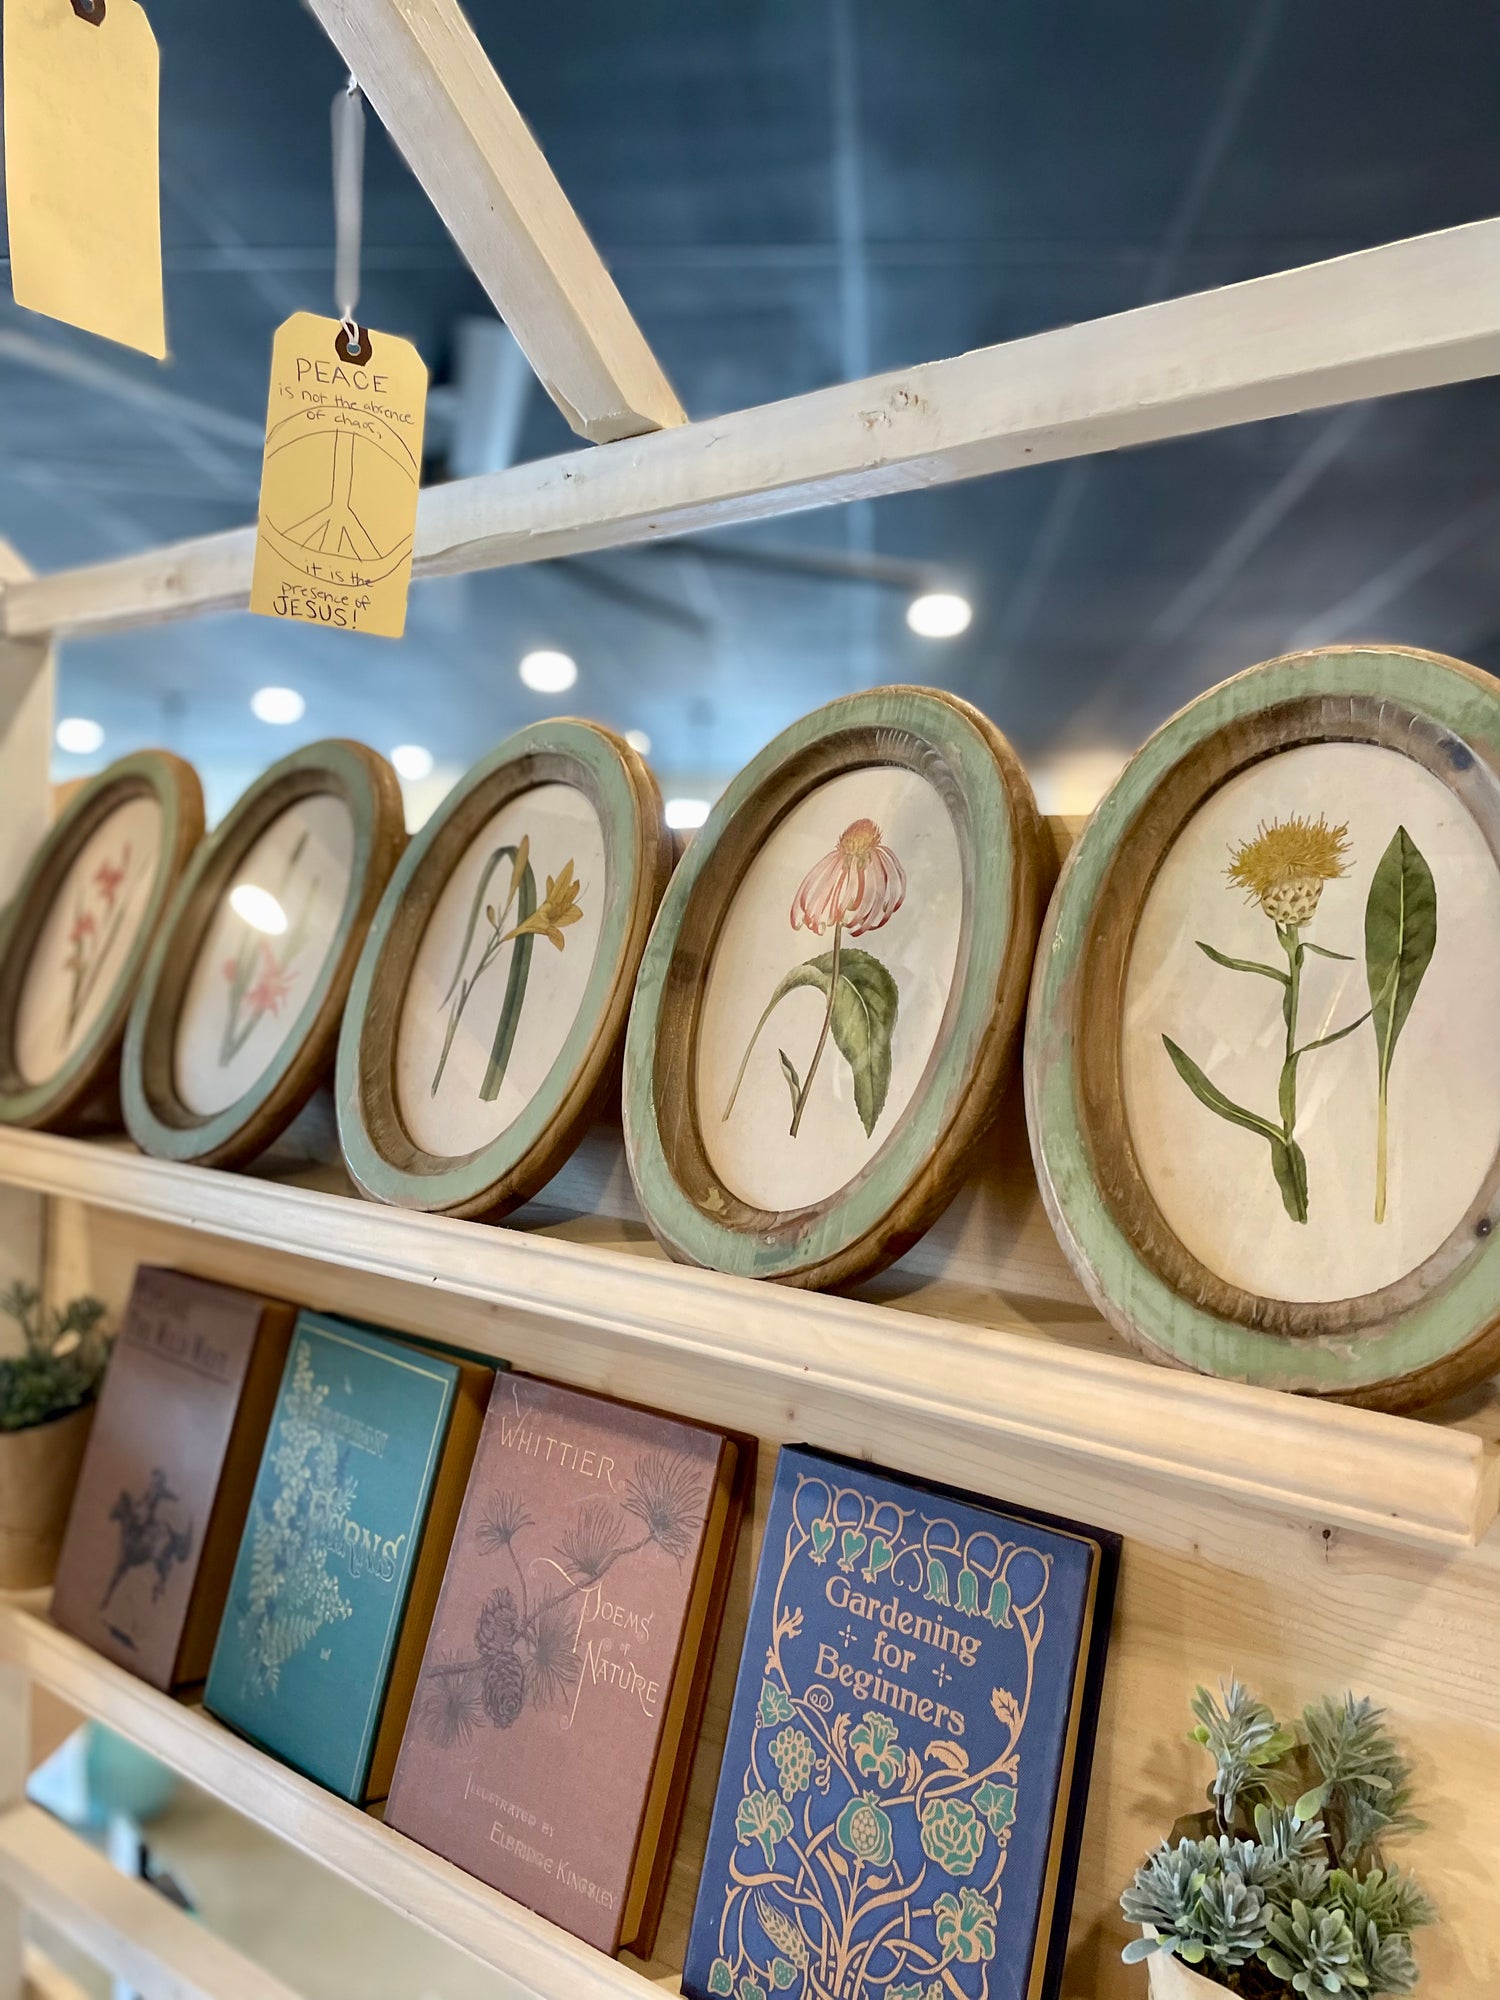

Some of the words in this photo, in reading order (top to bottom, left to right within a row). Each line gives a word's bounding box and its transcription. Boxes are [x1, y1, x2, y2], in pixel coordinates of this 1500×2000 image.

[279, 383, 294, 399] is
[301, 389, 329, 405] not
[334, 395, 358, 410] the
[296, 358, 389, 393] PEACE
[306, 409, 326, 420] of
[281, 581, 350, 606] presence
[354, 594, 371, 611] of
[305, 560, 322, 577] it
[329, 565, 345, 582] is
[351, 571, 374, 588] the
[273, 595, 357, 630] JESUS!
[500, 1402, 617, 1493] WHITTIER
[538, 1560, 655, 1652] POEMS
[825, 1575, 982, 1668] Gardening
[872, 1630, 917, 1674] for
[560, 1640, 660, 1730] NATURE
[814, 1642, 966, 1736] Beginners
[490, 1820, 554, 1874] ELBRIDGE
